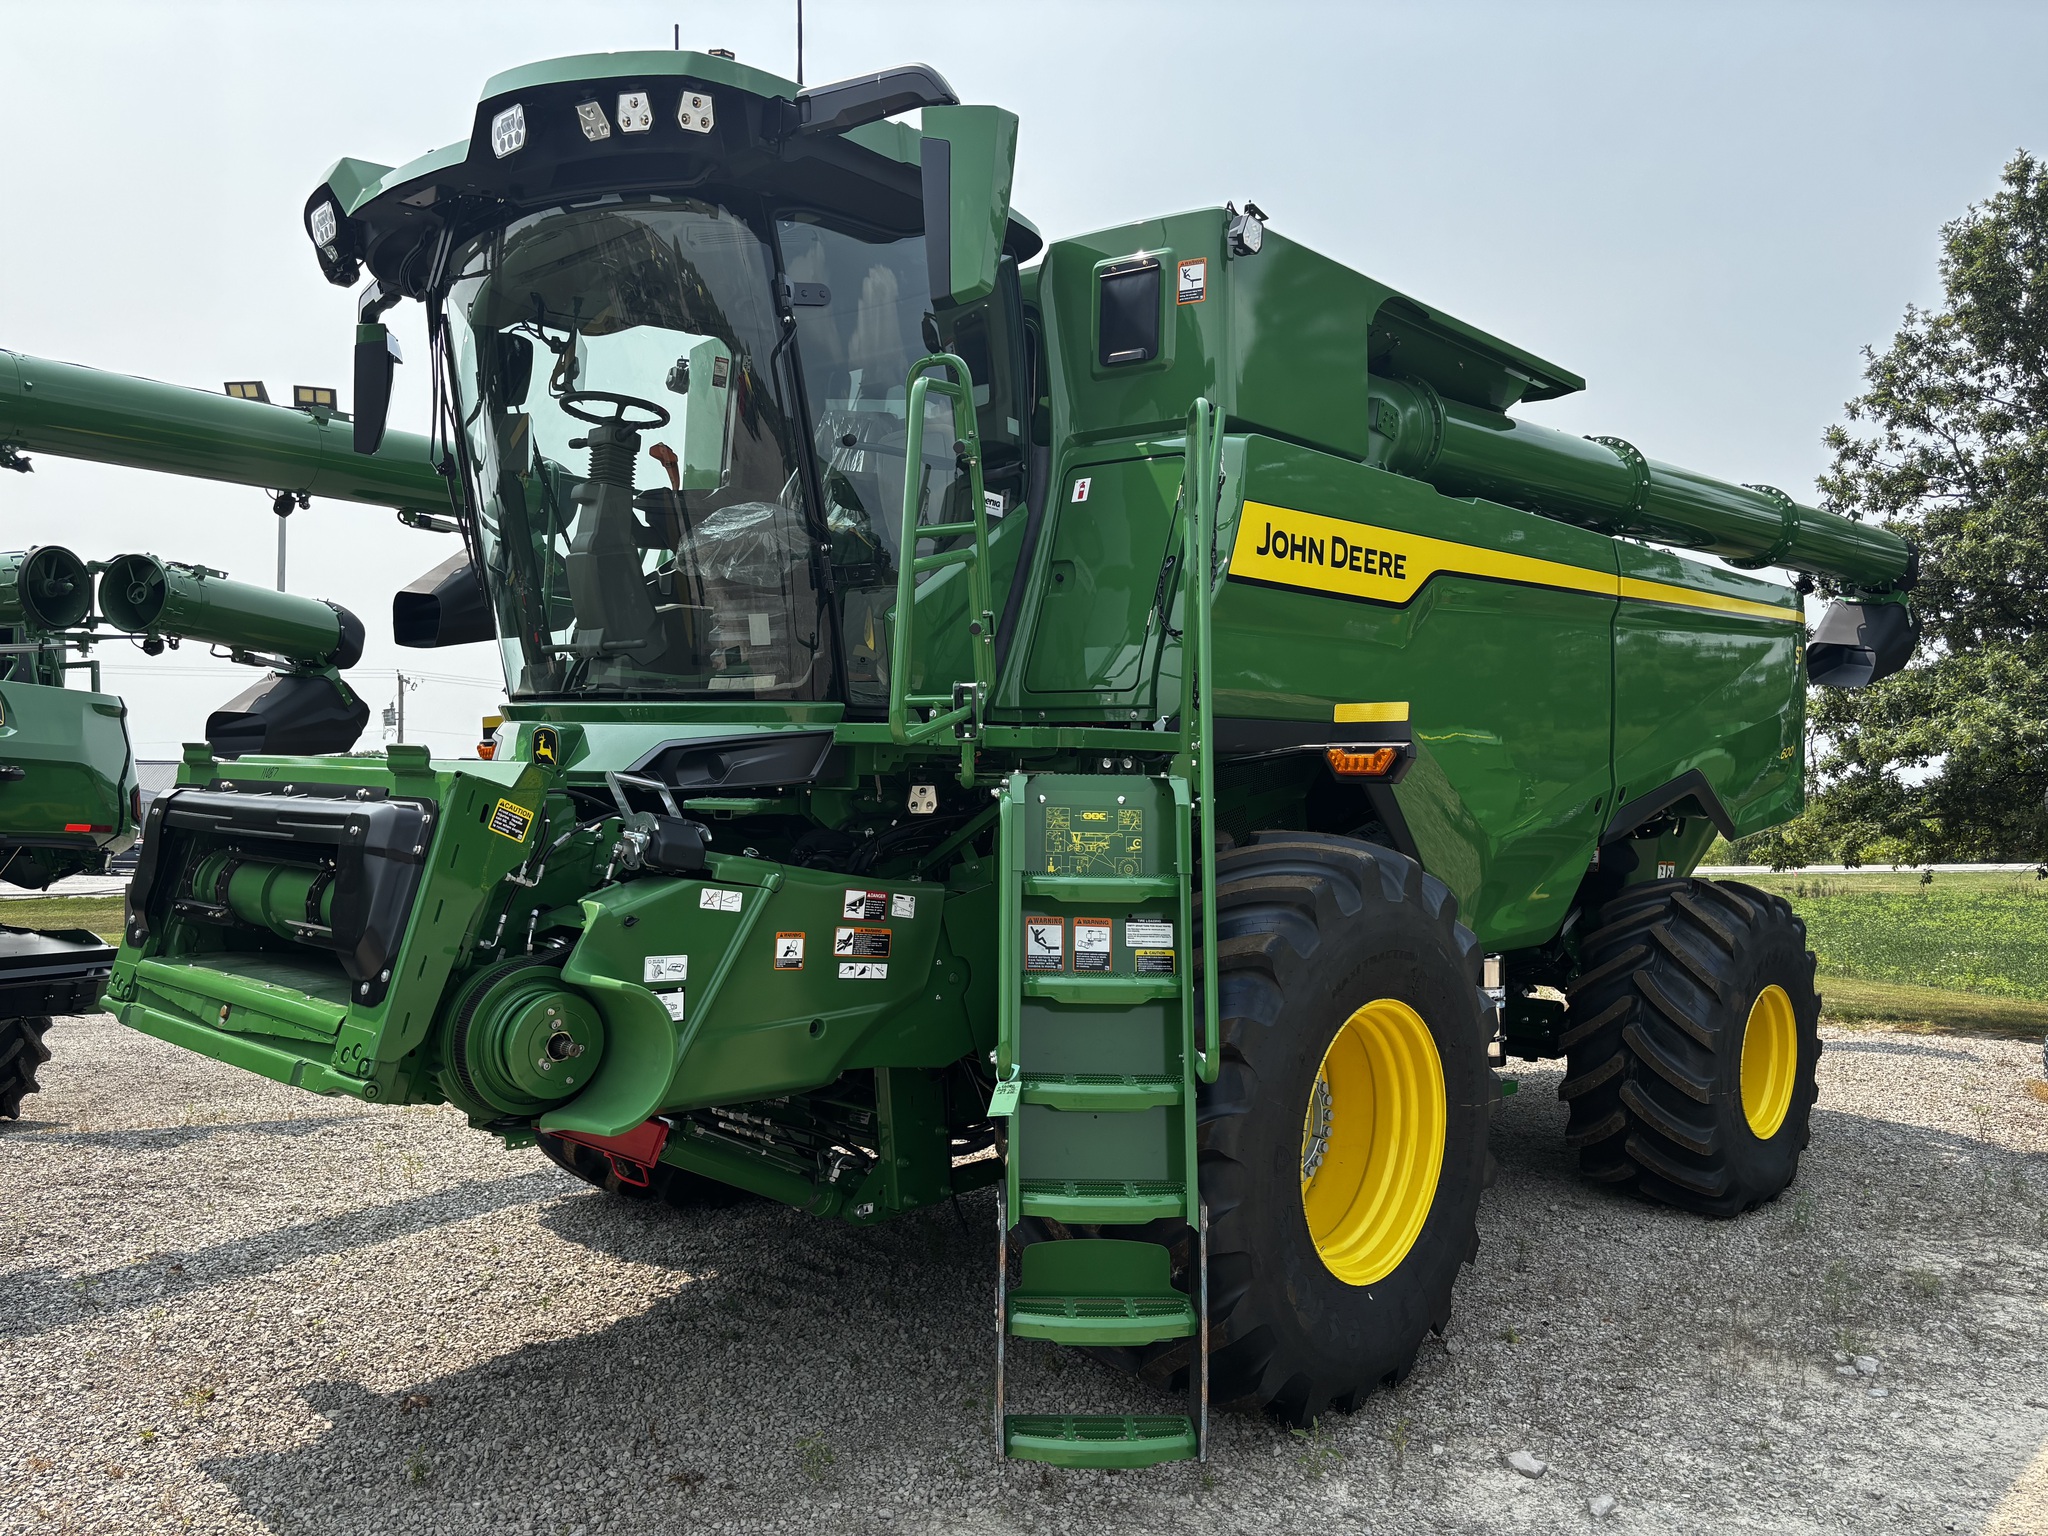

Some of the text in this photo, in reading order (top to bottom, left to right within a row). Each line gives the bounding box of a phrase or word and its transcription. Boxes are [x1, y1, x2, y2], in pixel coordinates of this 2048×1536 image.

[1256, 522, 1407, 580] JOHN DEERE
[504, 802, 532, 819] CAUTION
